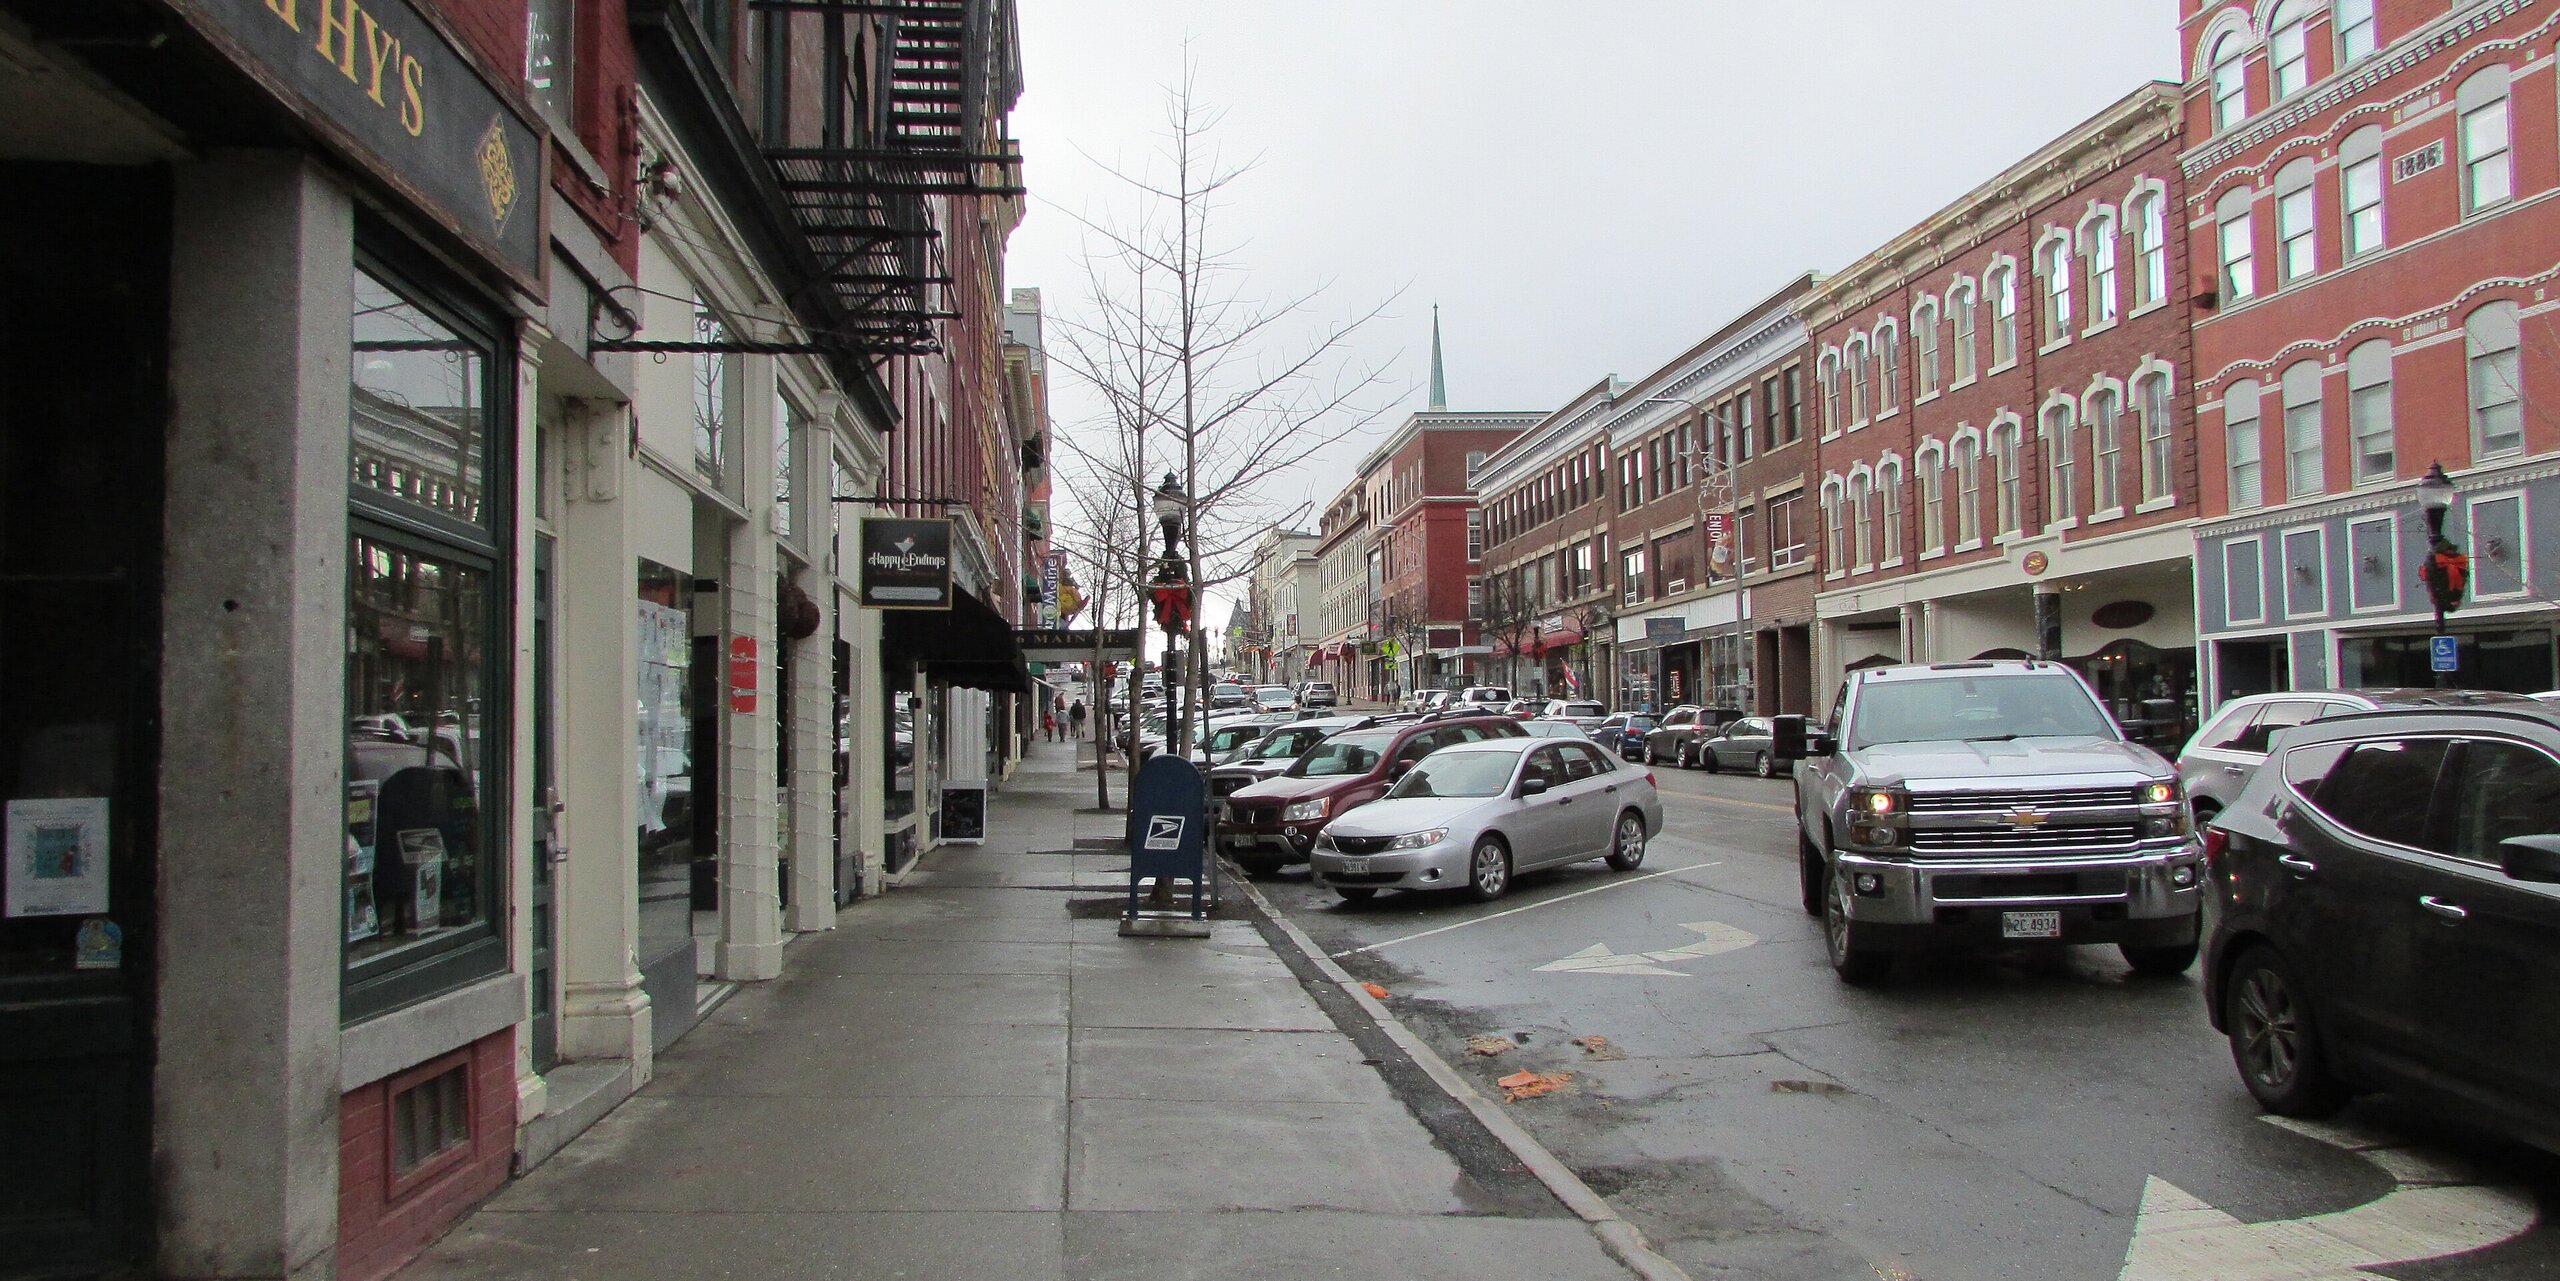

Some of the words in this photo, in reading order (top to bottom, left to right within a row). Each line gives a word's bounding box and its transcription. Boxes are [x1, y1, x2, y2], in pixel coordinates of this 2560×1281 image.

[868, 552, 900, 569] Happy
[902, 553, 946, 569] Endings
[1044, 558, 1058, 606] Maine
[1034, 634, 1087, 644] MAIN
